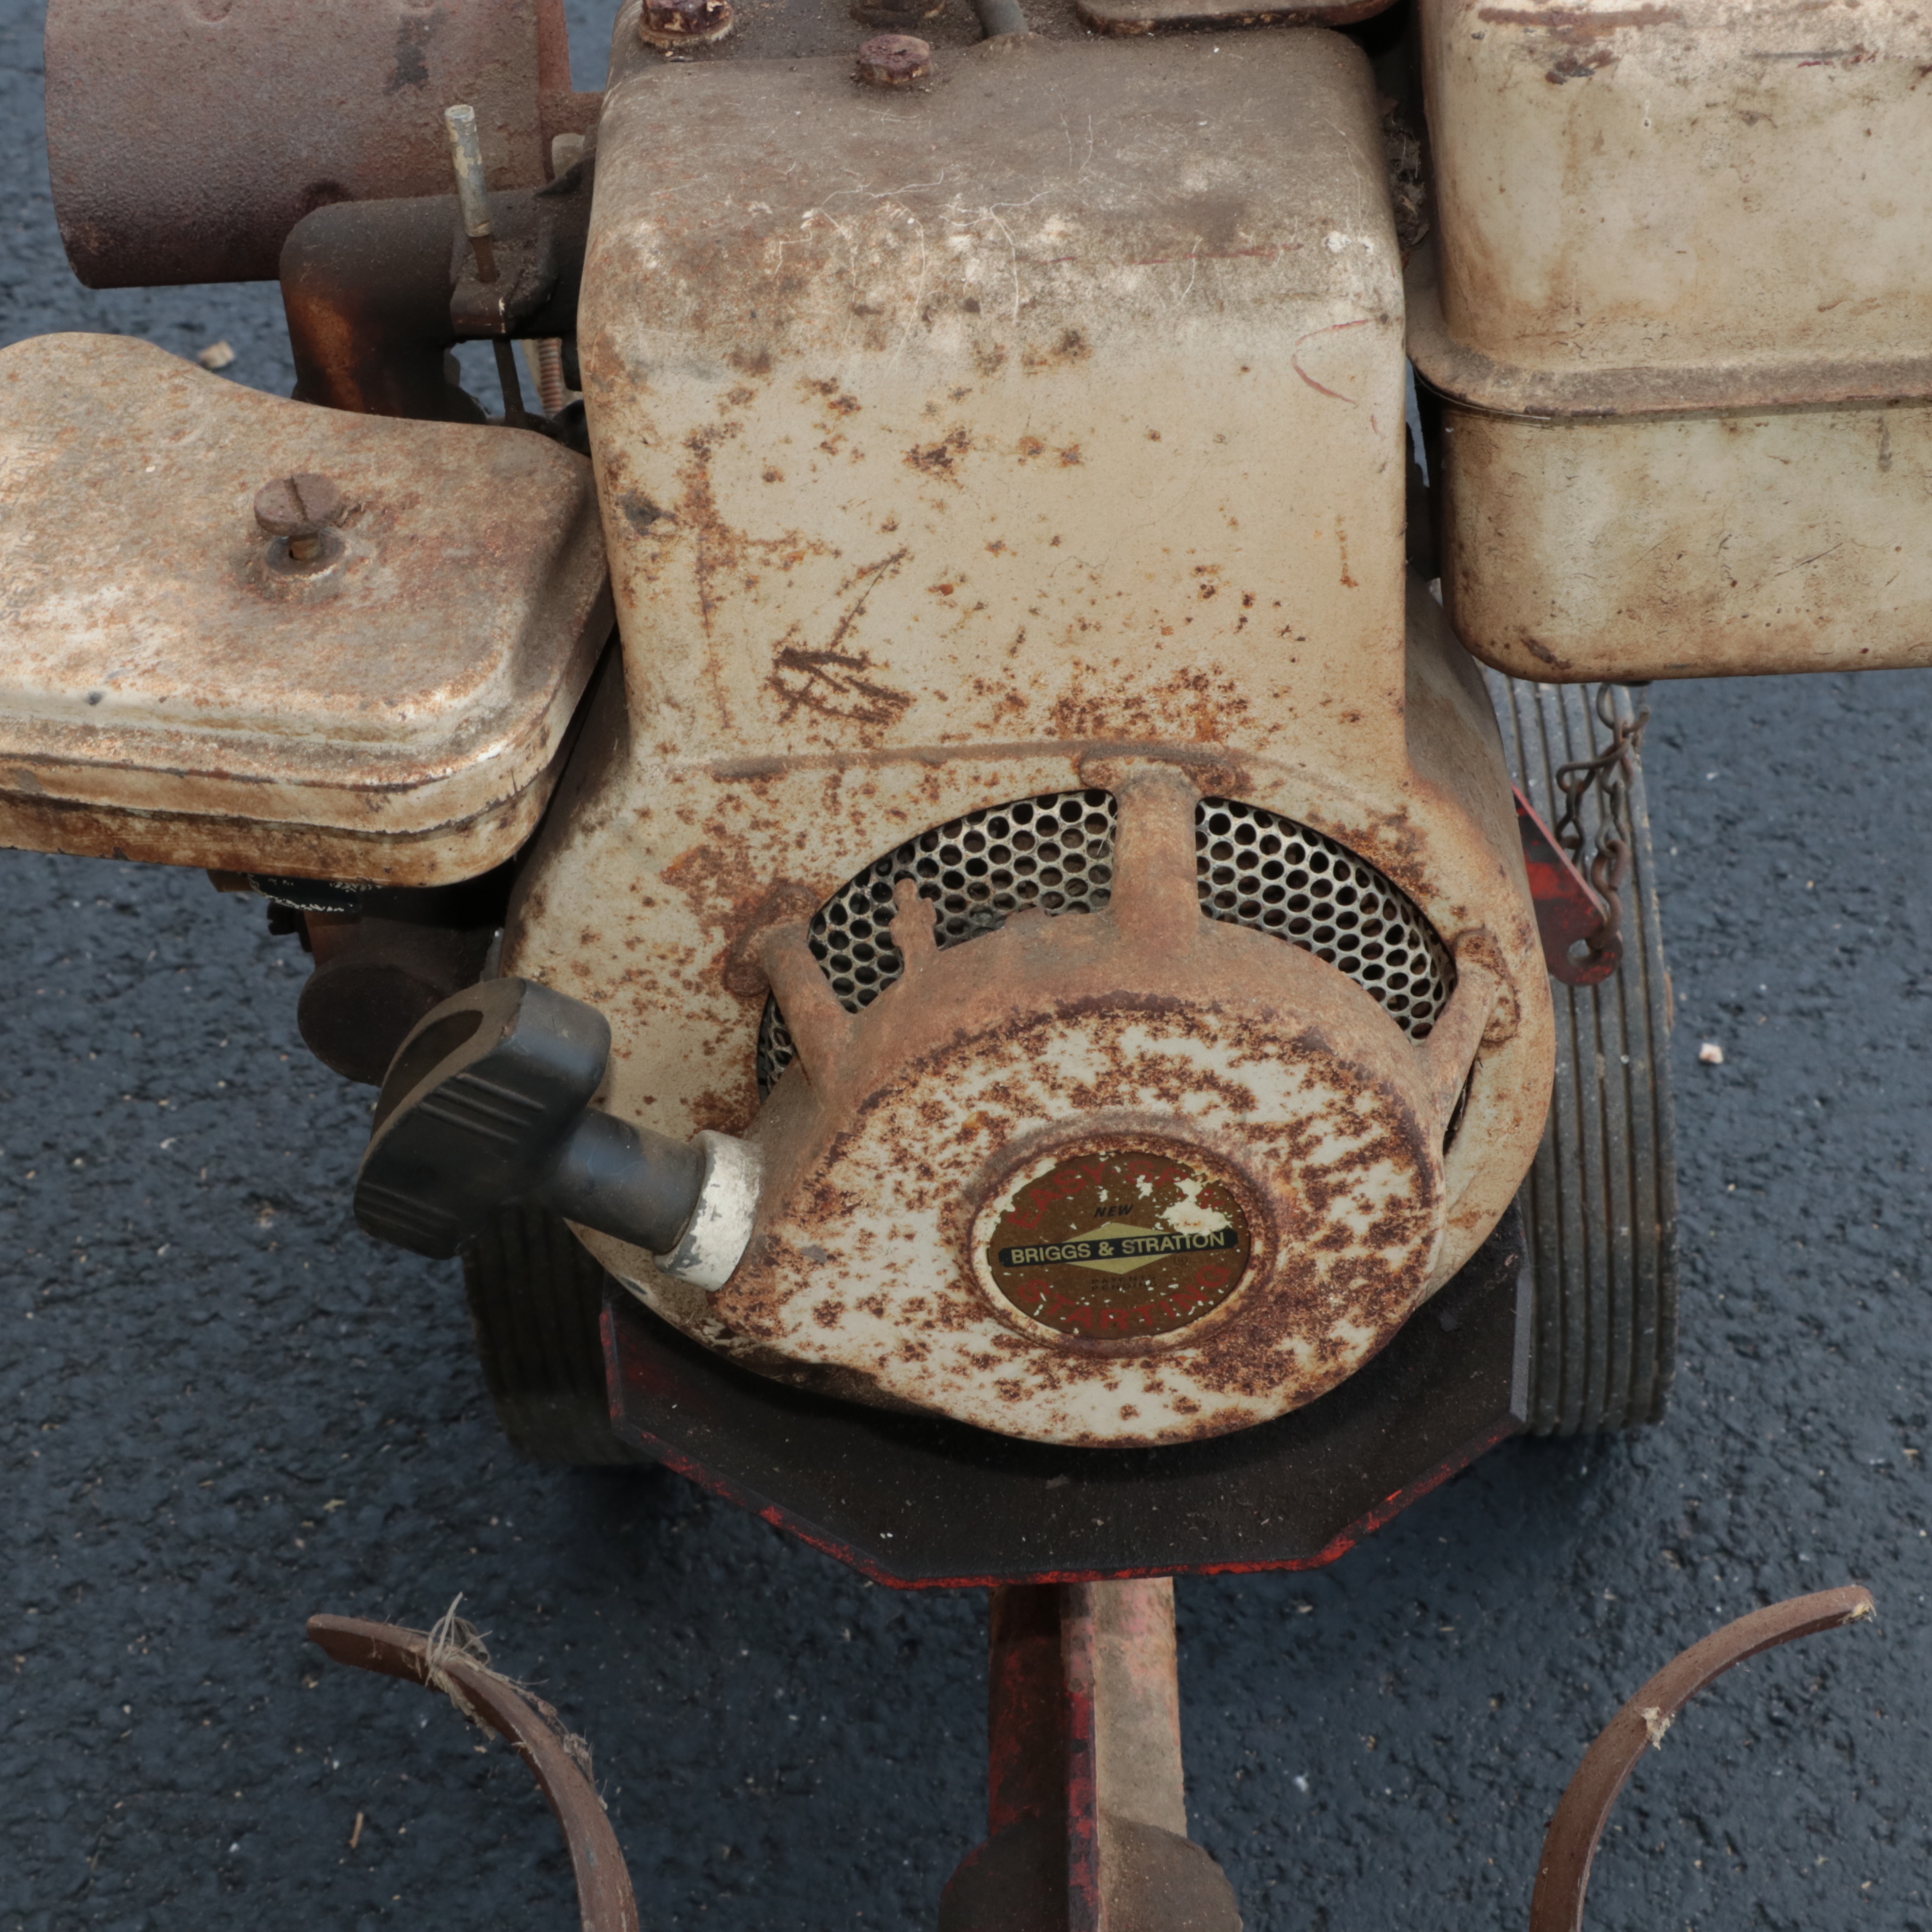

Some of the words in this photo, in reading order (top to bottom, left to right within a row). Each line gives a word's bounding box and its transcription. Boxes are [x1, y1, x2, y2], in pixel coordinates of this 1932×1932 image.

[1007, 1160, 1107, 1230] EASY
[1094, 1204, 1133, 1218] NEW
[1011, 1242, 1091, 1264] BRIGGS
[1098, 1241, 1114, 1257] &
[1122, 1231, 1226, 1255] STRATTON
[1019, 1264, 1231, 1330] STARTING
